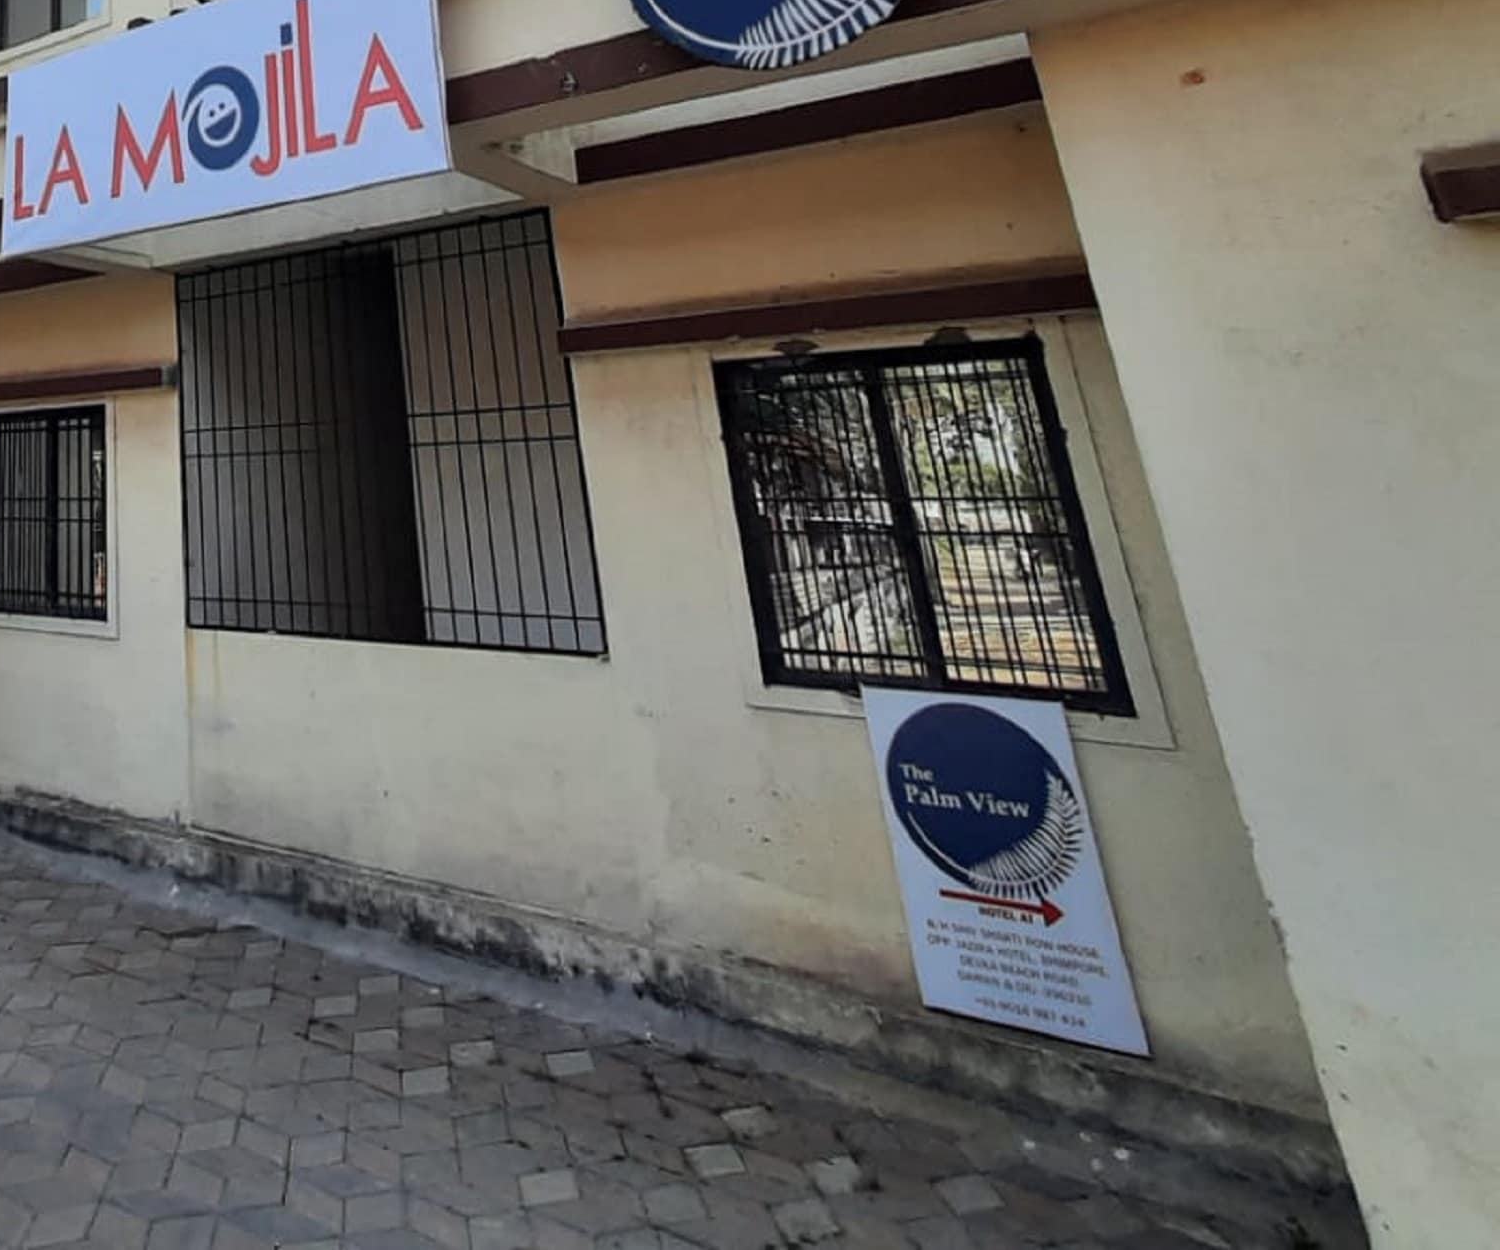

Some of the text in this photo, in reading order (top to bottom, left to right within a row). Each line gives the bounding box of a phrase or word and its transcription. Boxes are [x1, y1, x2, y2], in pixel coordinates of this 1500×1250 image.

[12, 123, 89, 222] LA
[898, 763, 933, 782] The
[903, 783, 1029, 818] Palm View
